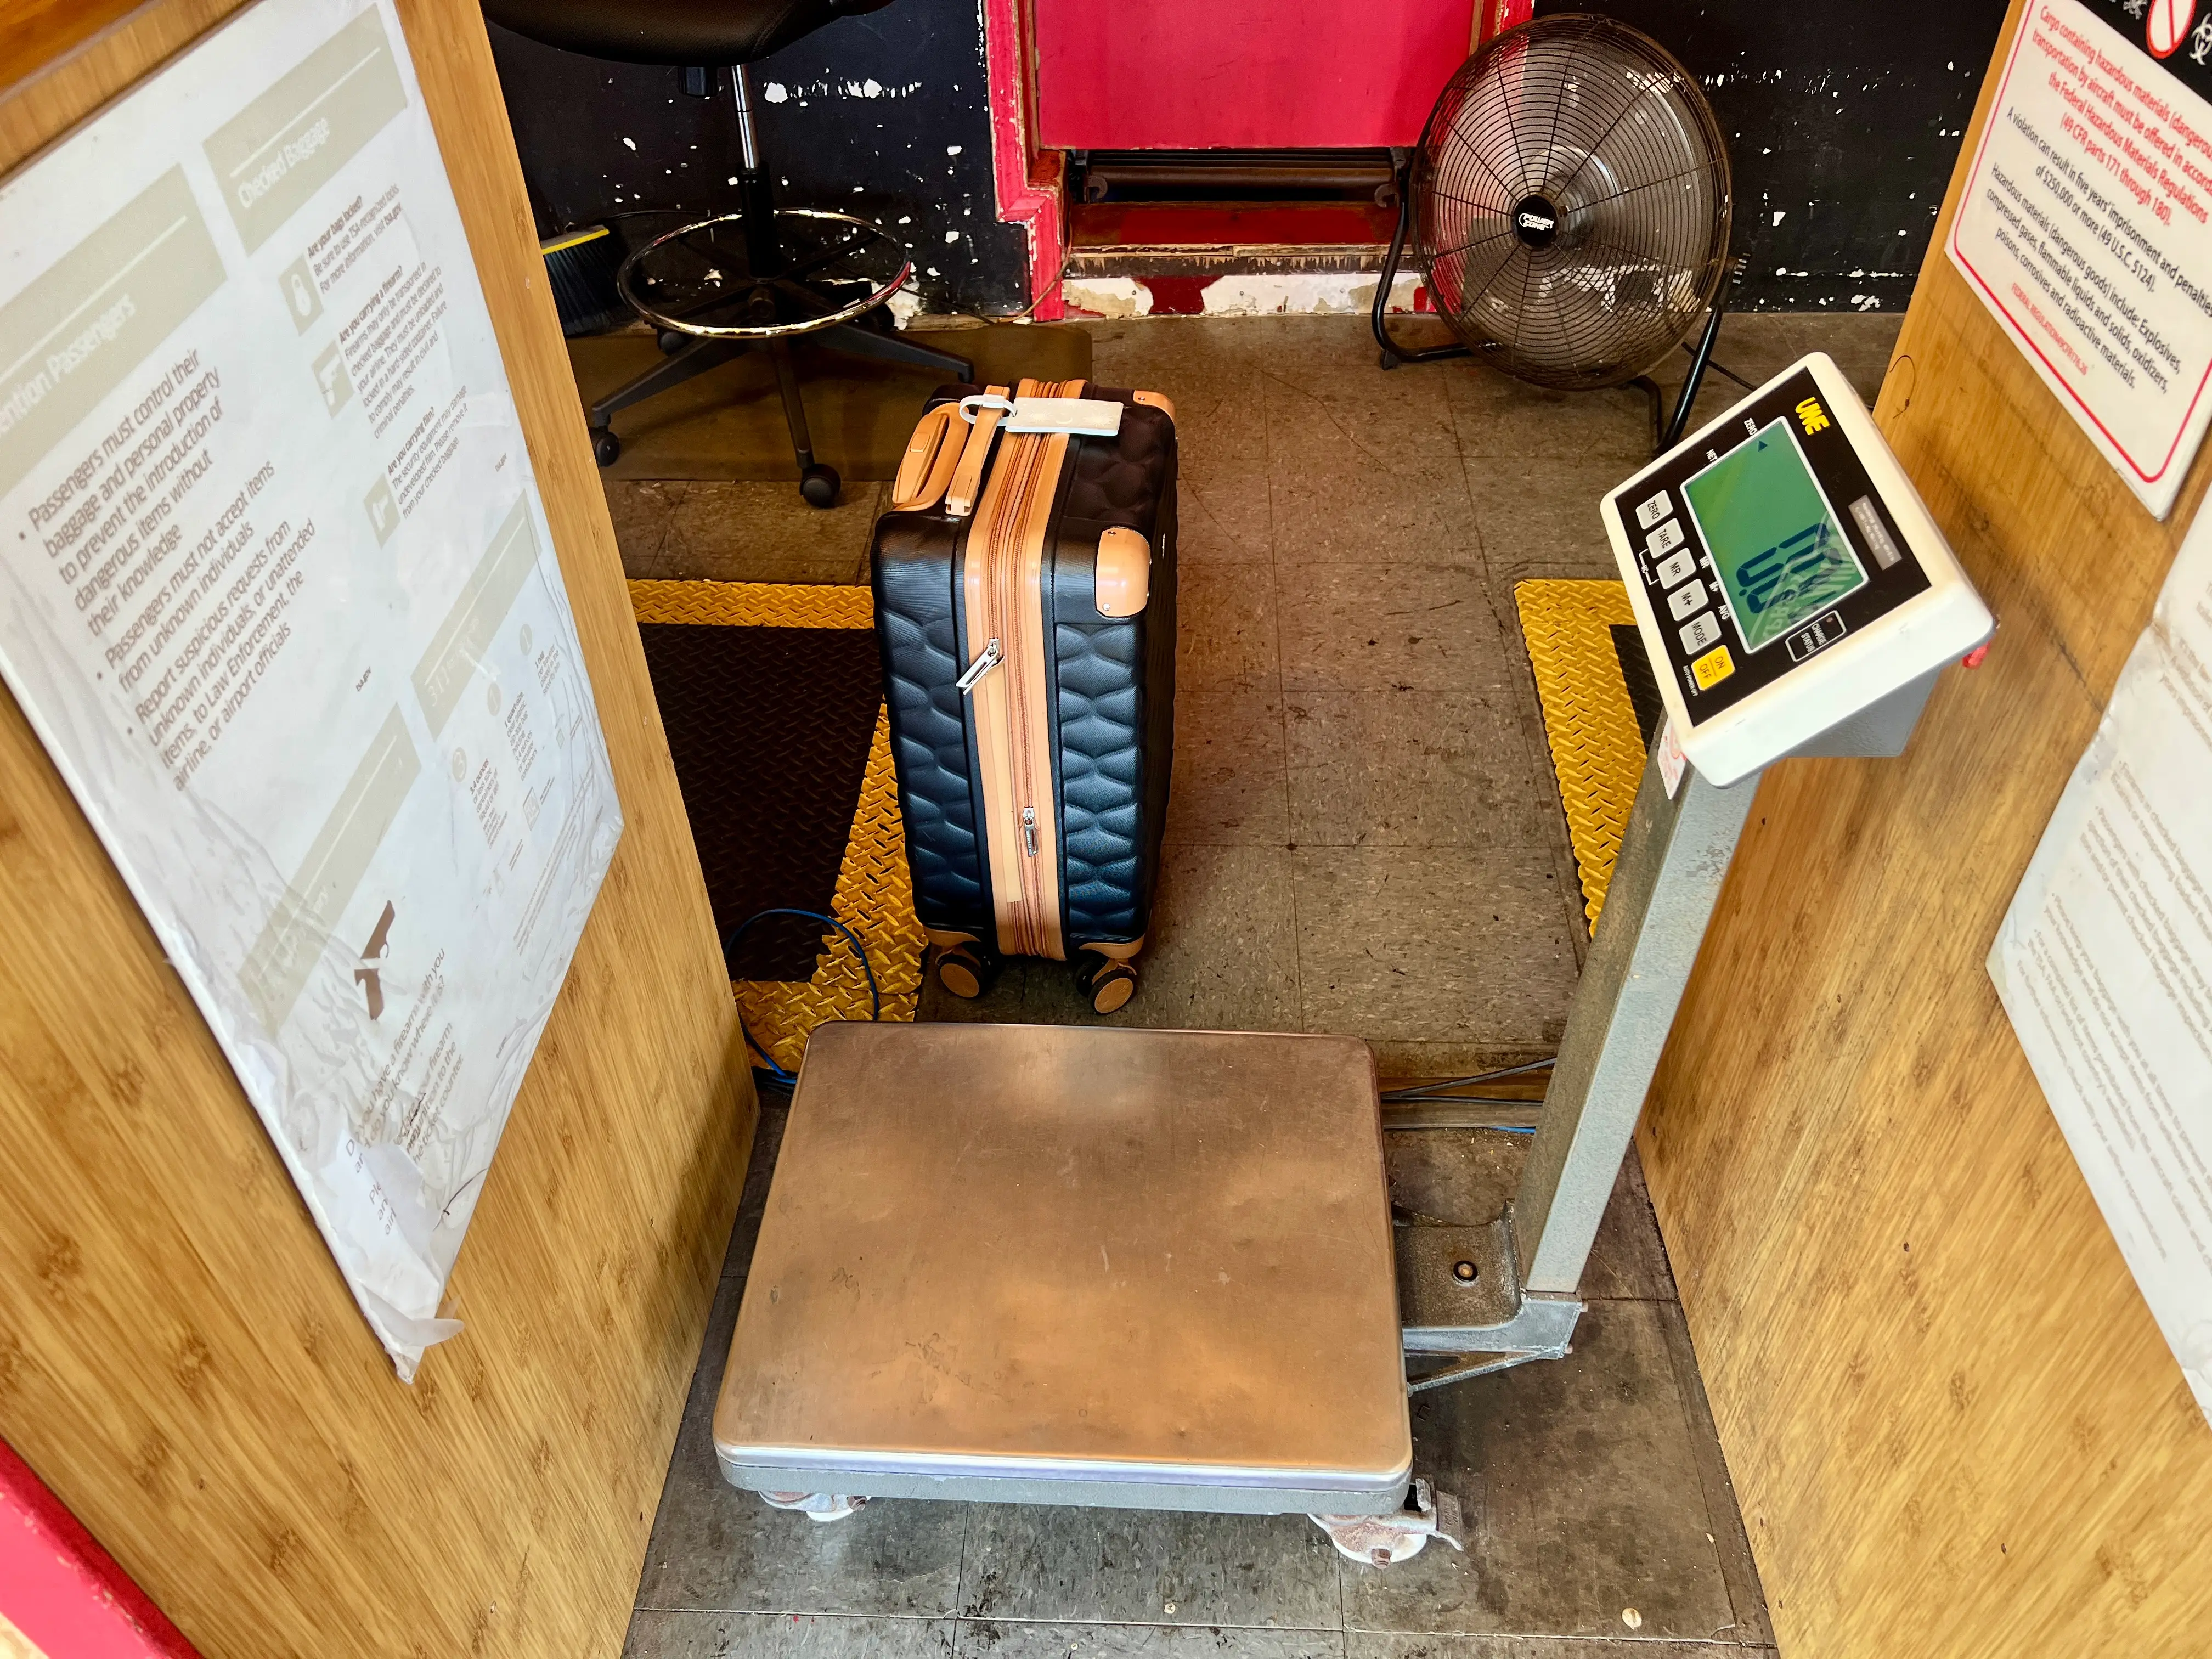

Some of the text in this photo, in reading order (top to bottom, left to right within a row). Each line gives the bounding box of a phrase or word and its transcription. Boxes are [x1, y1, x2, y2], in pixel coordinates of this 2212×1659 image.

[2033, 29, 2212, 196] transportation by aircraft must be offered in accord
[2040, 5, 2212, 161] Cargo containing hazardous materials (dangerou
[2007, 106, 2014, 121] A
[2013, 114, 2039, 145] violation
[2038, 140, 2051, 156] can
[2050, 150, 2069, 175] result
[2068, 165, 2076, 182] in
[2075, 172, 2089, 195] five
[2108, 204, 2162, 264] imprisonment
[2159, 258, 2180, 280] and
[2049, 72, 2208, 224] the Federal Hazardous Materials Regulations
[2060, 112, 2074, 132] (49
[2072, 124, 2088, 146] CFR
[2084, 139, 2107, 164] parts
[2106, 154, 2121, 176] 171
[2120, 168, 2151, 206] through
[2036, 166, 2046, 179] of
[2043, 170, 2074, 207] $250,000
[2072, 202, 2081, 216] or
[2079, 210, 2099, 235] more
[2097, 225, 2112, 246] (49
[1987, 189, 2168, 393] compressed gases, flammable liquids and solids, oxidizers,
[1991, 163, 2022, 202] Hazardous
[2021, 198, 2050, 232] materials
[2048, 224, 2086, 270] (dangerous
[2084, 266, 2112, 298] goods)
[2138, 319, 2180, 374] Explosives,
[1995, 227, 2019, 260] poisons,
[2020, 255, 2051, 293] corrosives
[2050, 287, 2066, 307] and
[2063, 302, 2101, 348] radioactive
[46, 294, 137, 384] Passengers
[29, 349, 200, 531] Passengers must control their
[43, 368, 220, 558] baggage and personal property
[1706, 449, 1718, 462] NET
[1743, 418, 1757, 435] ZERO
[1795, 397, 1832, 436] UWE
[59, 396, 223, 586] to prevent the introduction of
[75, 449, 213, 612] dangerous items without
[1646, 500, 1660, 520] ZERO
[87, 525, 182, 637] their knowledge
[105, 461, 274, 669] Passengers must not accept items
[1658, 528, 1672, 549] TARE
[1669, 561, 1681, 577] MR
[1699, 556, 1709, 569] MR
[119, 522, 254, 693] from unknown individuals
[135, 521, 291, 729] Report suspicious requests from
[147, 676, 201, 747] unknown
[253, 585, 266, 607] or
[265, 518, 315, 590] unattended
[1681, 591, 1692, 607] M+
[1691, 621, 1707, 646] MODE
[1718, 605, 1730, 620] AVG
[1801, 632, 1815, 653] STATUS
[1812, 623, 1827, 645] CHARGE
[192, 703, 208, 724] to
[205, 672, 229, 708] Law
[286, 571, 304, 596] the
[208, 717, 222, 741] or
[221, 670, 256, 723] airport
[255, 623, 291, 676] officials
[1700, 664, 1712, 679] OFF
[1715, 656, 1725, 670] ON
[429, 1023, 453, 1071] firearm
[437, 1041, 456, 1082] to the
